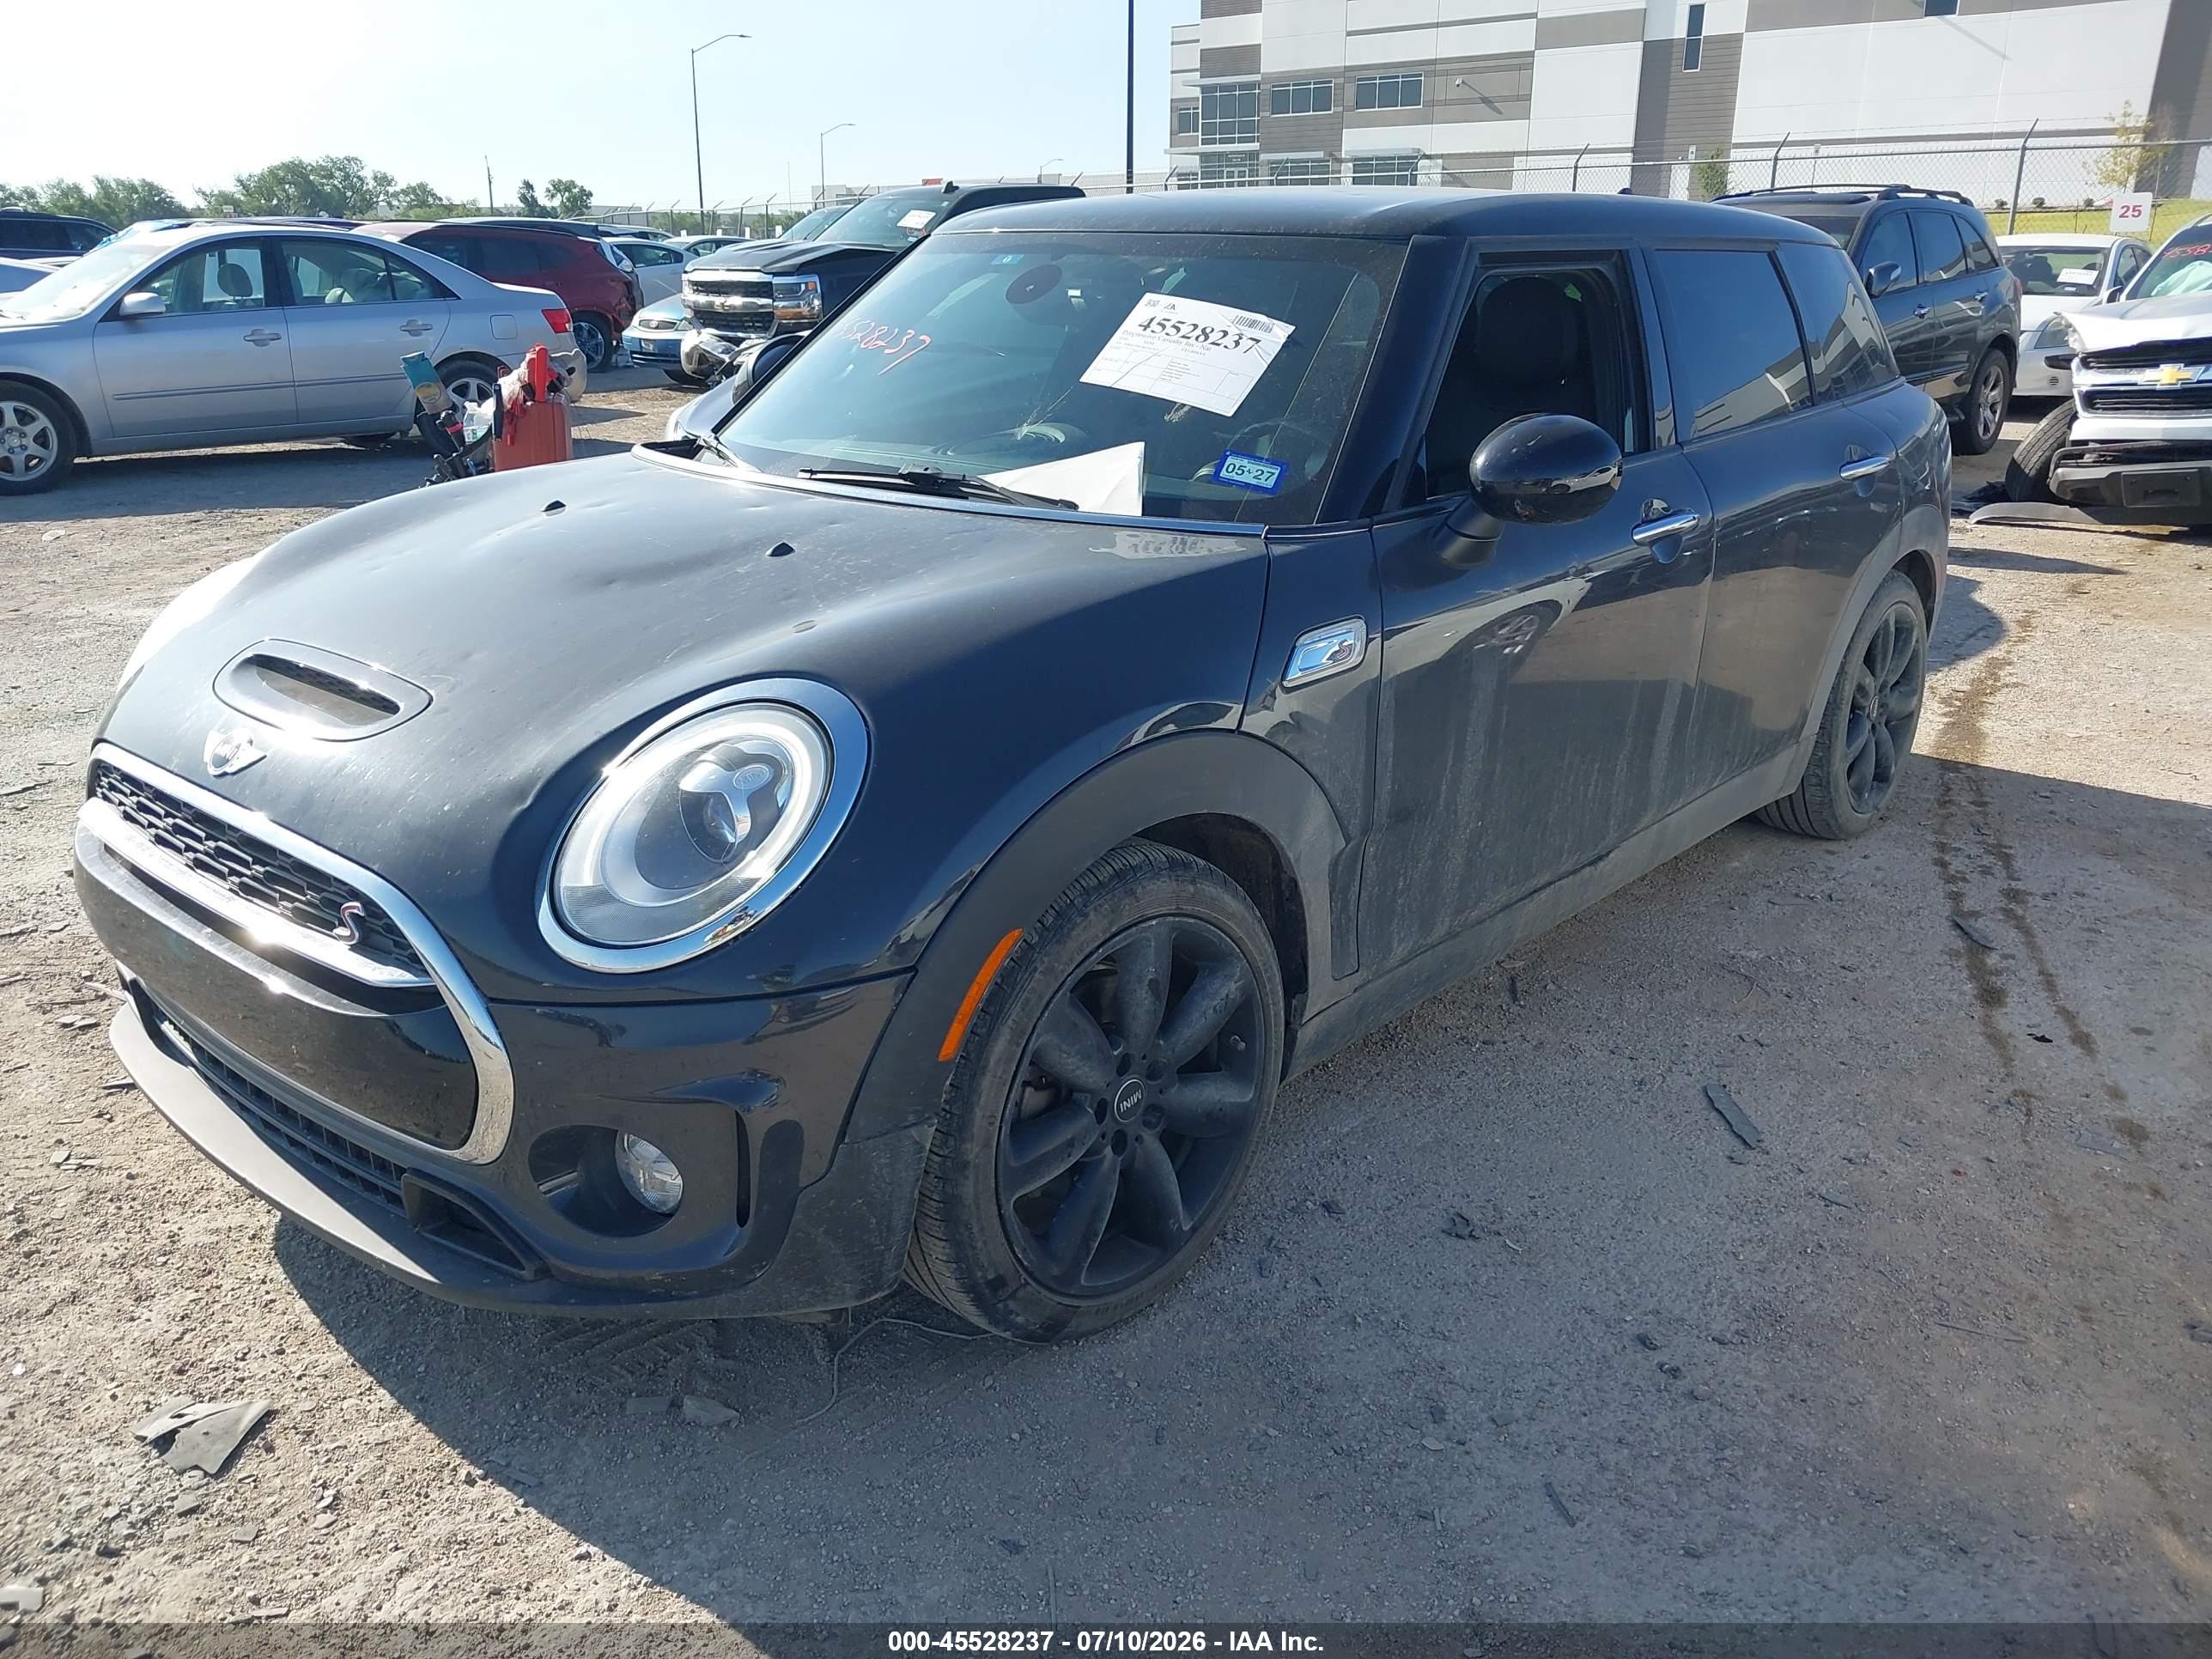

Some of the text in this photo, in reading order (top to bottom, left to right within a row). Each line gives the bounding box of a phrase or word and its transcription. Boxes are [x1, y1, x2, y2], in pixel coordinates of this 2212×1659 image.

[2118, 204, 2143, 219] 25
[1138, 315, 1261, 355] 45528237
[1225, 462, 1248, 476] 05
[1252, 469, 1277, 483] 27
[332, 901, 365, 945] S
[1120, 1089, 1142, 1114] MINI
